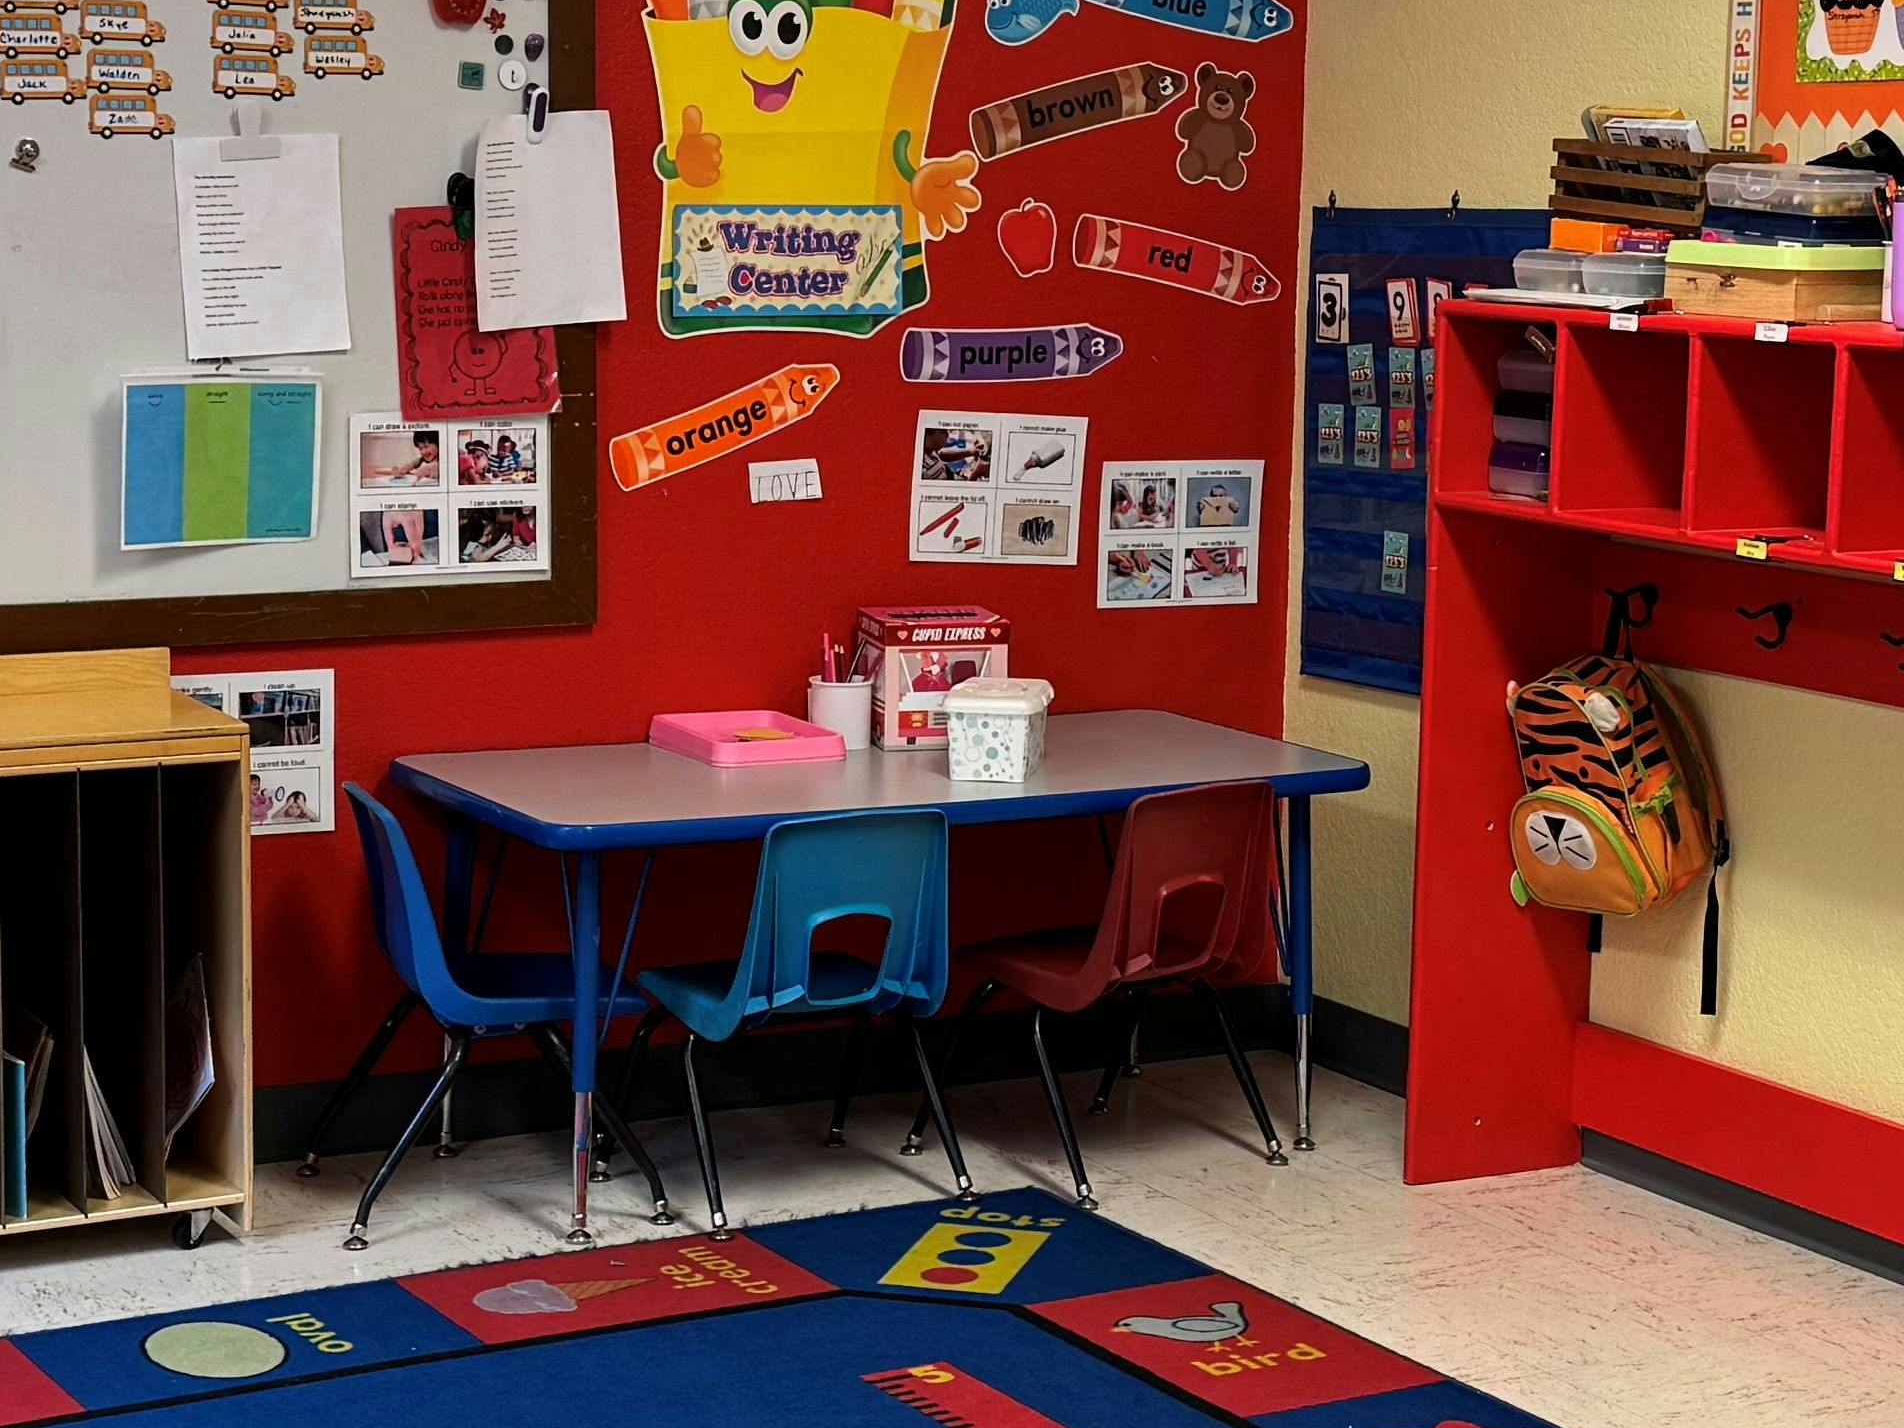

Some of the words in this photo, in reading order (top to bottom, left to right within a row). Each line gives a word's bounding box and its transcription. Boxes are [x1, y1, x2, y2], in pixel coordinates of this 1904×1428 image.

[1027, 84, 1115, 130] brown
[717, 220, 860, 264] Writing
[1147, 240, 1192, 274] red
[728, 266, 849, 297] Center
[958, 334, 1048, 375] purple
[665, 398, 768, 457] orange
[755, 470, 817, 501] LOVE
[911, 627, 942, 642] CUPID
[944, 626, 986, 642] EXPRESS
[939, 1204, 1067, 1231] stop
[662, 1260, 721, 1287] ice
[679, 1249, 777, 1293] cream
[263, 1319, 351, 1356] oval
[1194, 1339, 1326, 1375] bird
